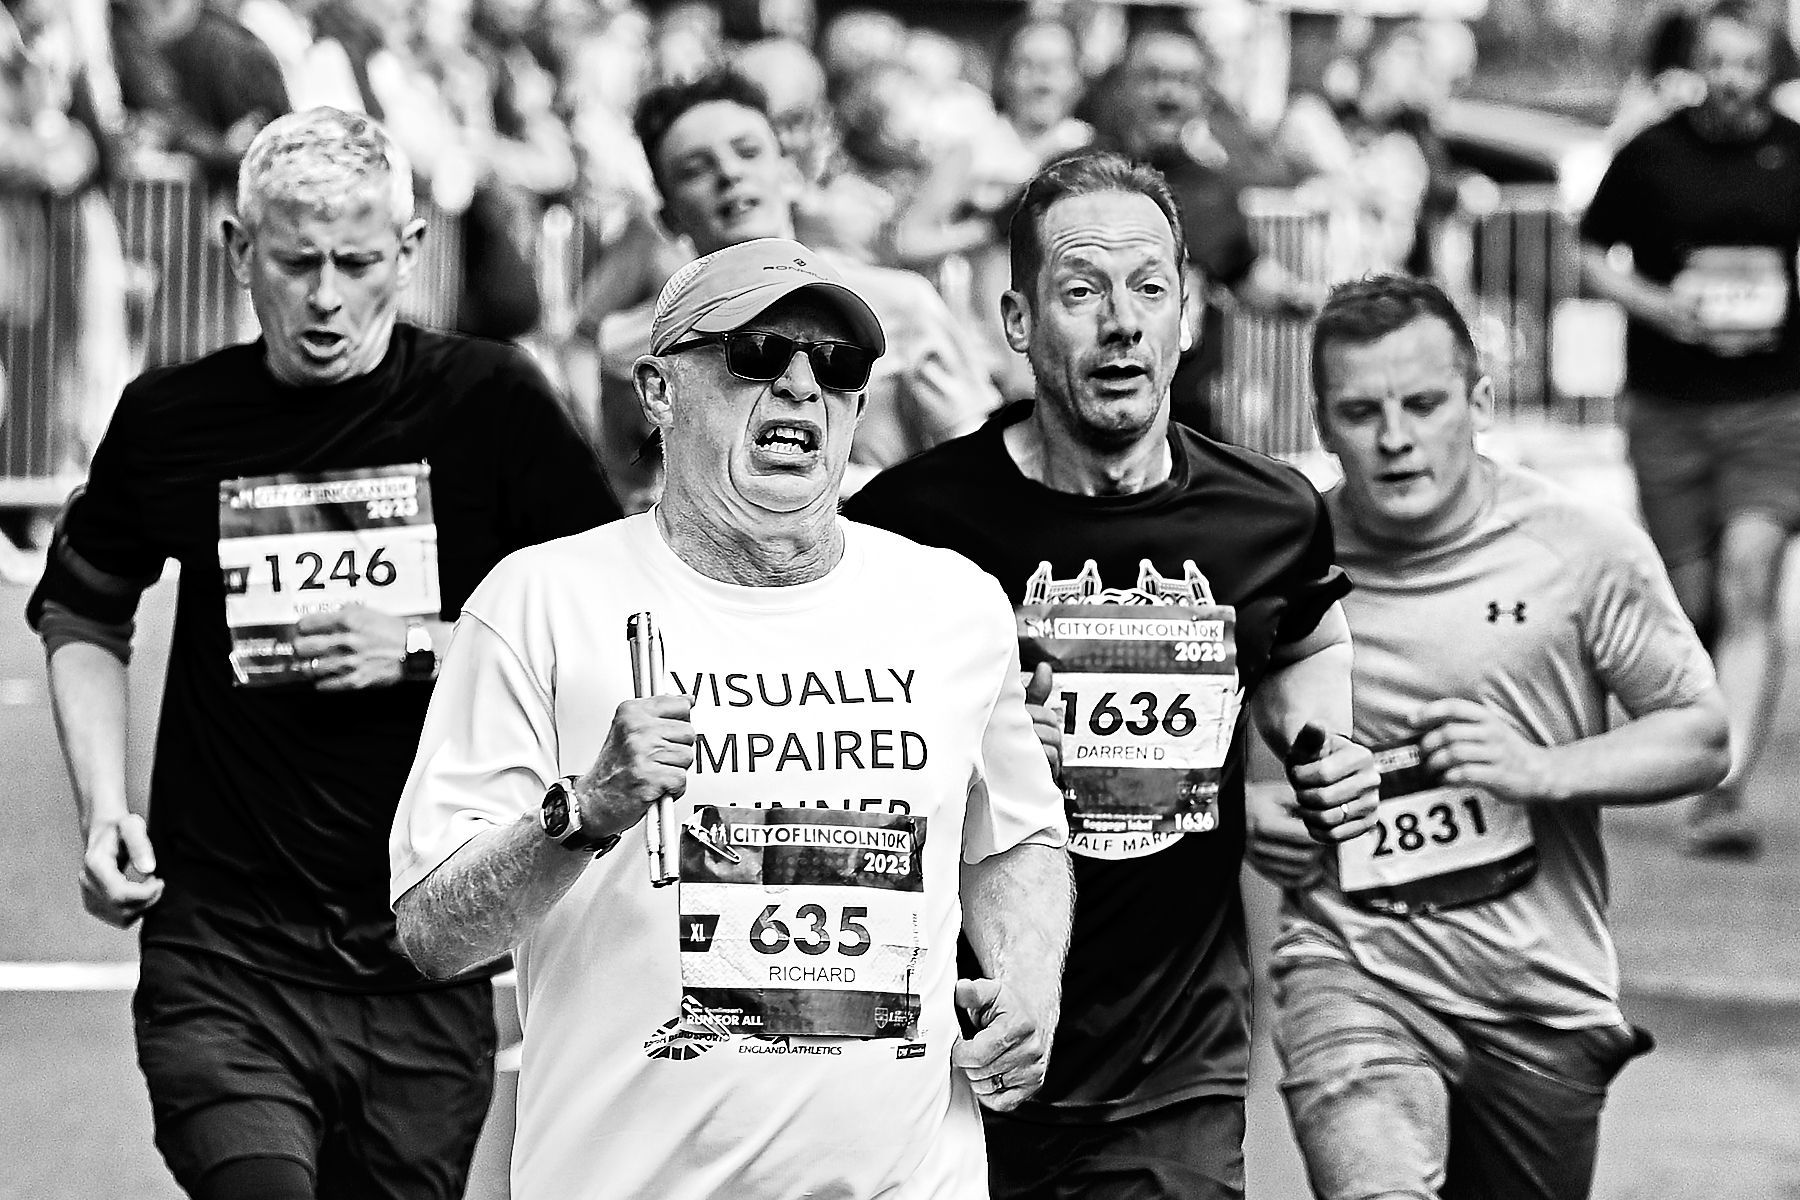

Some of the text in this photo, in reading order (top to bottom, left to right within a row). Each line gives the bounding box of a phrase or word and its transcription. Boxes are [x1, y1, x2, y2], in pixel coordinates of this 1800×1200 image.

[366, 498, 419, 520] 2023
[265, 547, 397, 593] 1246
[1174, 641, 1227, 662] 2023
[670, 668, 915, 707] VISUALLY
[1060, 691, 1197, 737] 1636
[694, 729, 928, 774] MPAIRED
[1077, 745, 1166, 761] DARREN D
[1174, 811, 1215, 830] 1636
[1373, 796, 1487, 857] 2831
[863, 851, 911, 876] 2023
[689, 923, 706, 942] XL
[750, 903, 871, 957] 635
[769, 966, 856, 983] RICHARD
[715, 1014, 740, 1026] FOR
[741, 1015, 764, 1026] ALL
[738, 1045, 842, 1055] ENGLAND ATHLETICS
